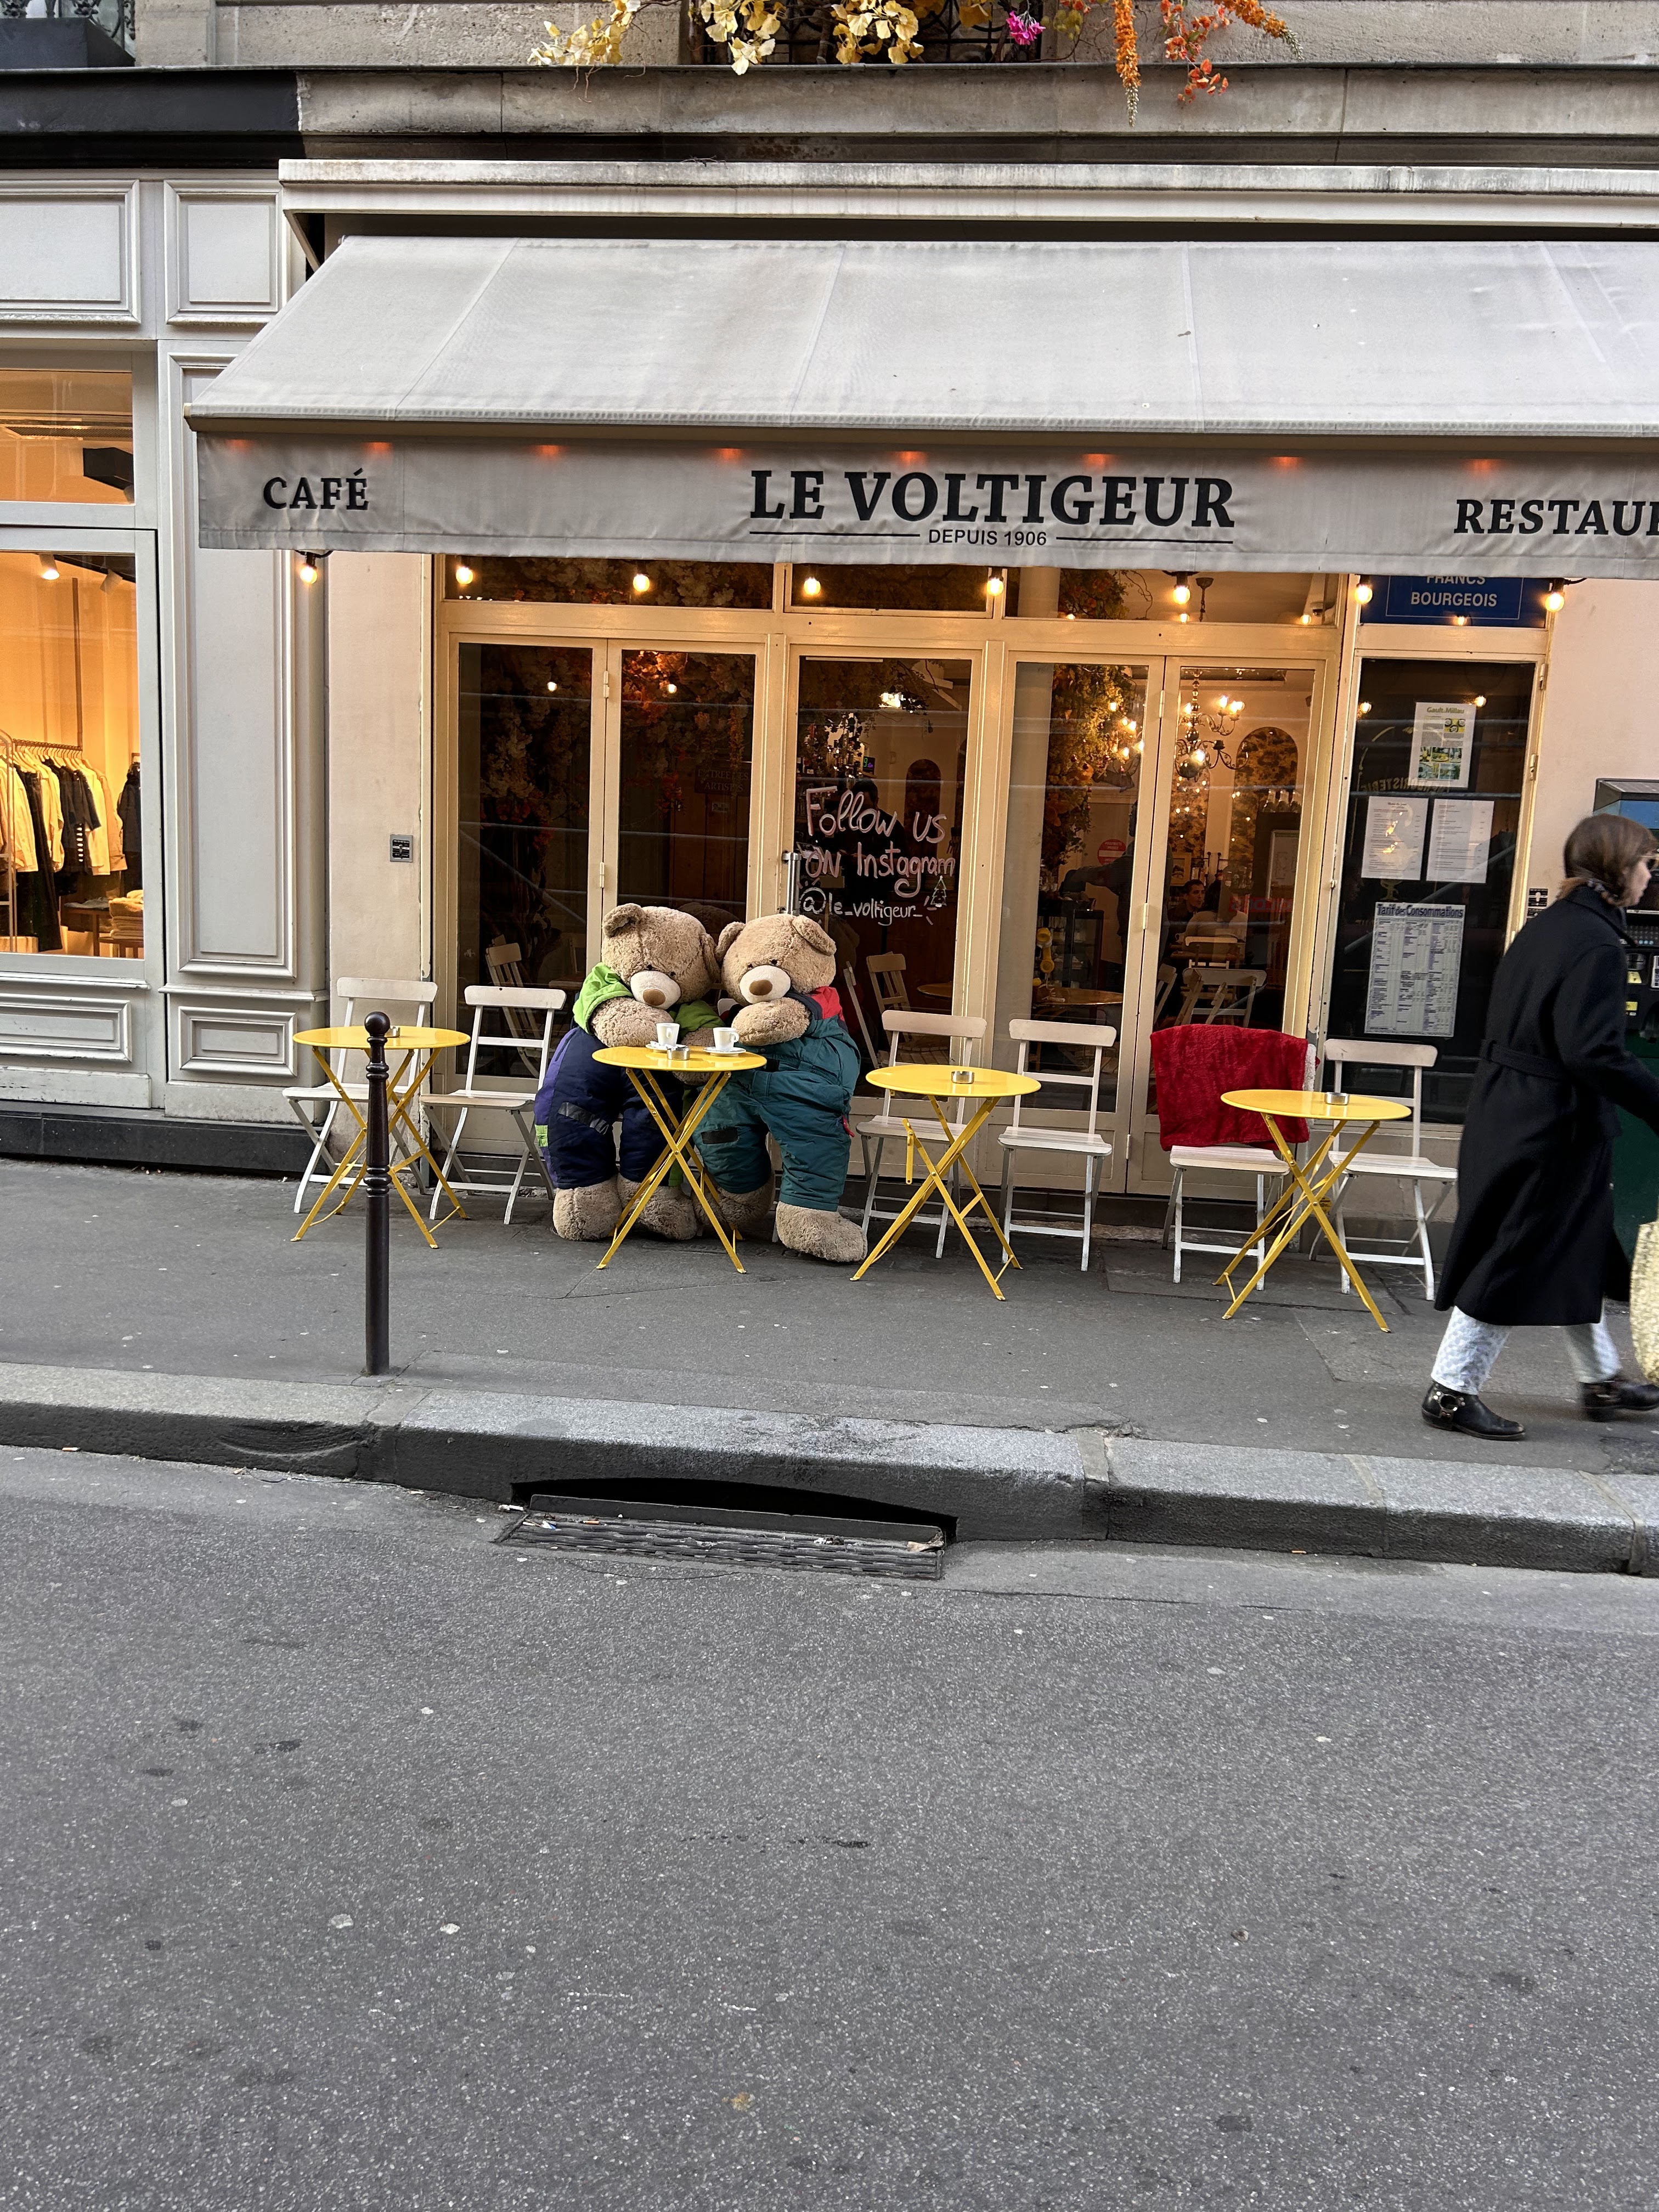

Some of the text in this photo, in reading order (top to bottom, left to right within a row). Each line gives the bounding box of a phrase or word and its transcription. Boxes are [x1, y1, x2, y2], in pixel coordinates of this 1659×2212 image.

[263, 467, 369, 510] CAFÉ
[749, 470, 1235, 528] LE VOLTIGEUR
[928, 528, 1047, 546] DEPUIS 1906
[1411, 592, 1497, 607] BOURGEOIS
[704, 782, 743, 792] ARTISTS
[806, 786, 898, 837] Follow
[857, 840, 956, 898] Instagram
[1378, 904, 1464, 918] Tarif des Consommations
